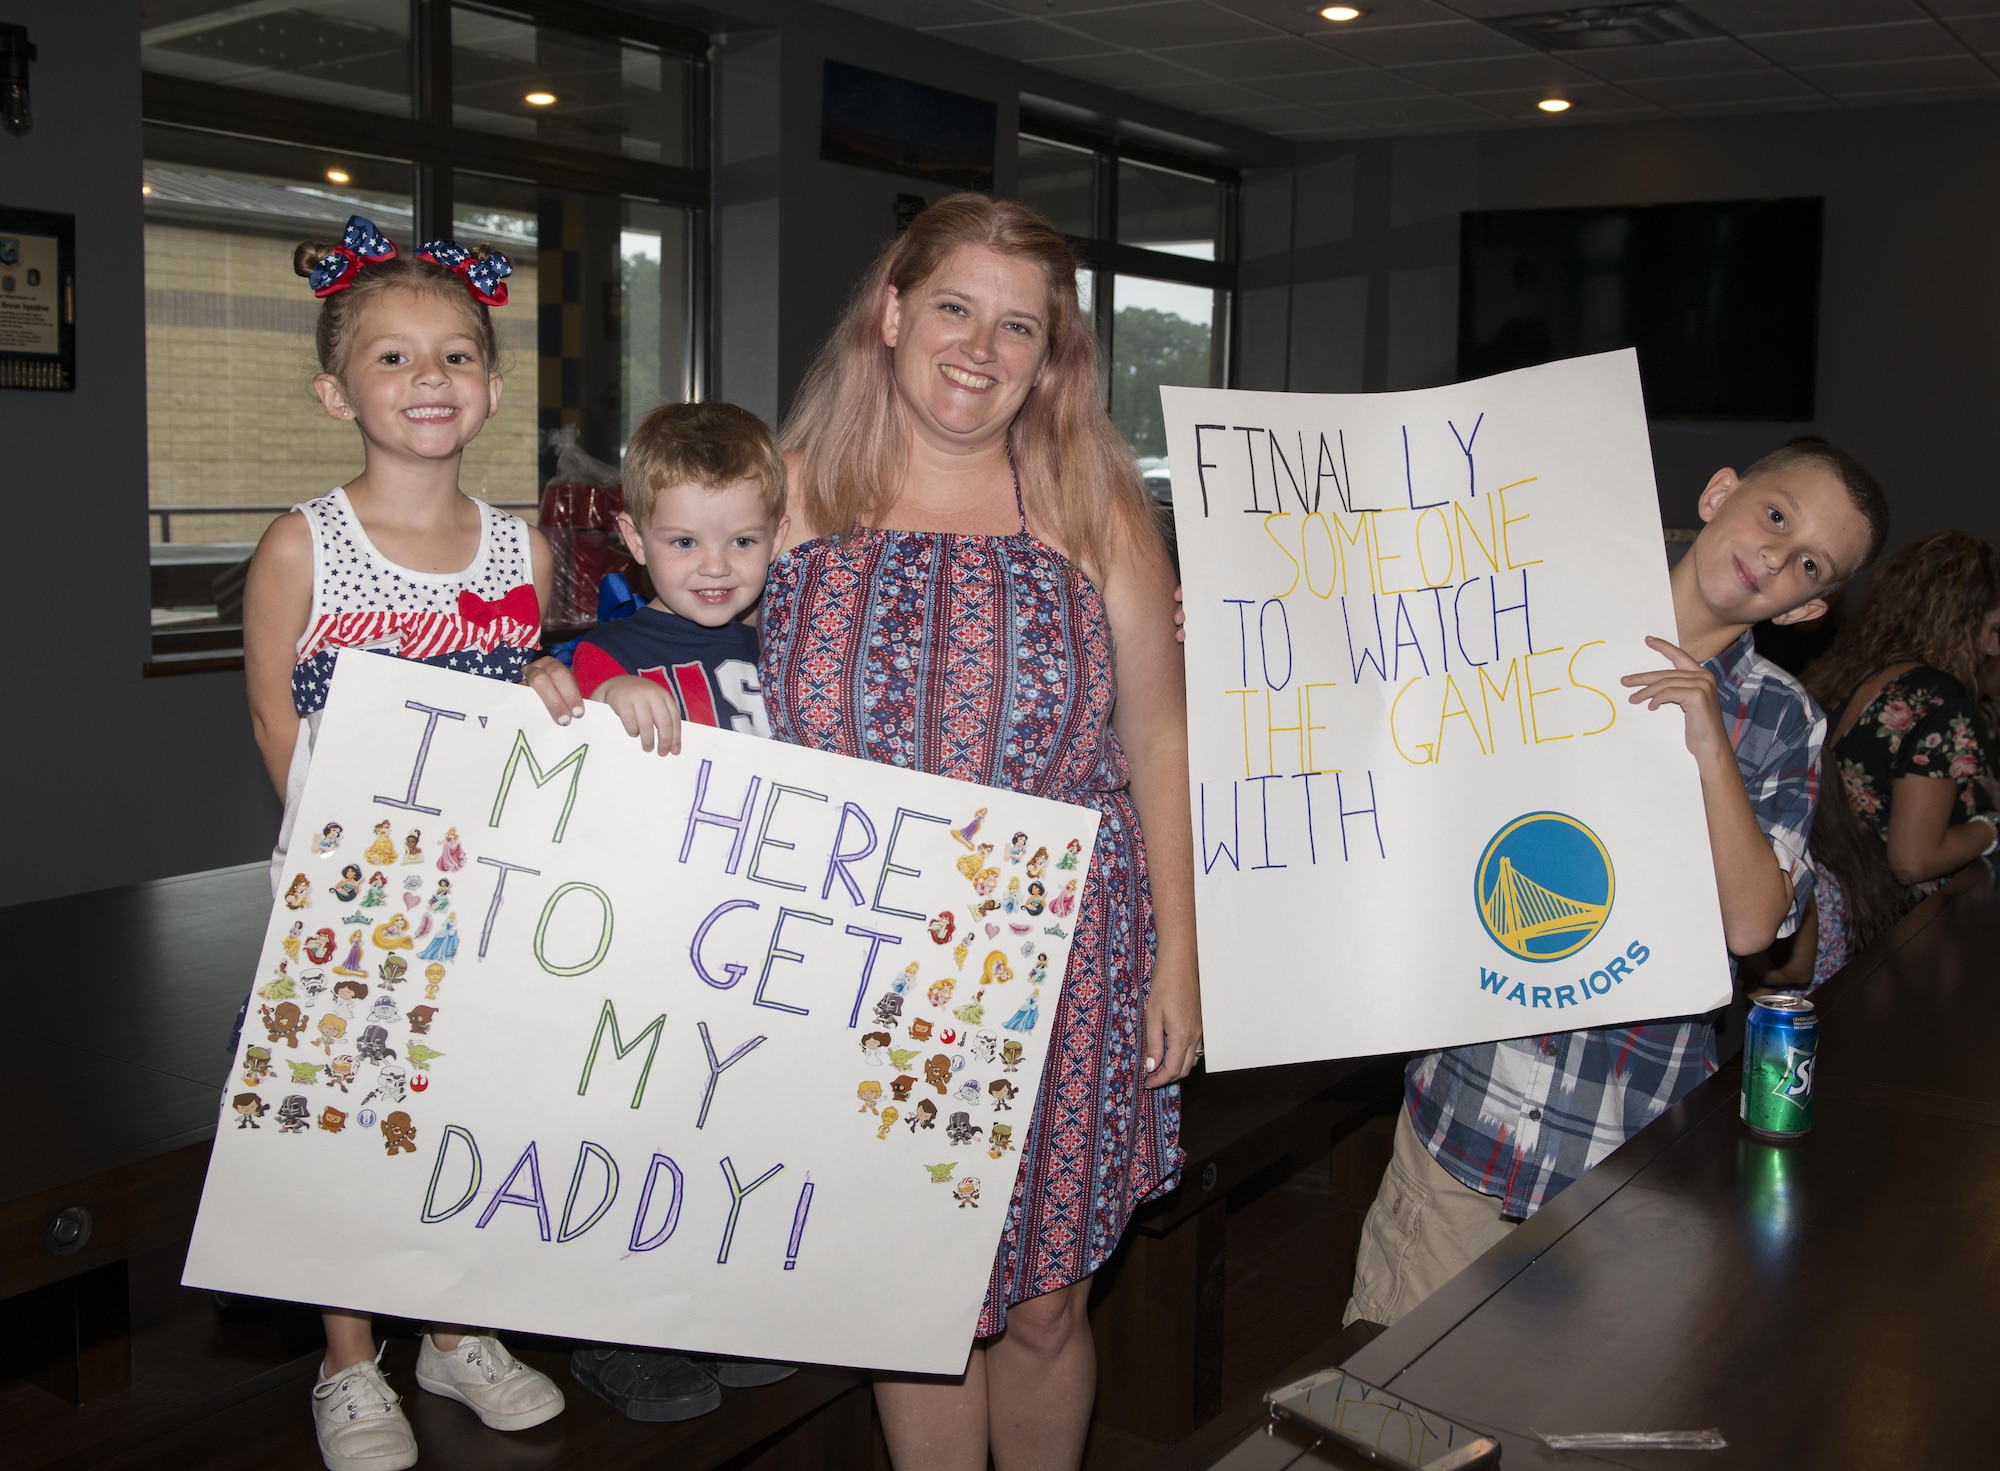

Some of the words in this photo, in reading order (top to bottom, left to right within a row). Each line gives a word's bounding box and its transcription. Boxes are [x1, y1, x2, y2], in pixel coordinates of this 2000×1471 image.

[1264, 476, 1544, 600] SOMEONE
[1223, 597, 1293, 691] TO
[1341, 569, 1533, 684] WATCH
[1224, 682, 1342, 777] THE
[1390, 640, 1616, 765] GAMES
[373, 700, 589, 844] I'M
[678, 758, 952, 922] HERE
[1200, 770, 1386, 875] WITH
[476, 855, 615, 978] TO
[688, 898, 902, 1030] GET
[1479, 939, 1651, 1010] WARRIORS
[577, 998, 768, 1130] MY
[421, 1124, 815, 1271] DADDY!
